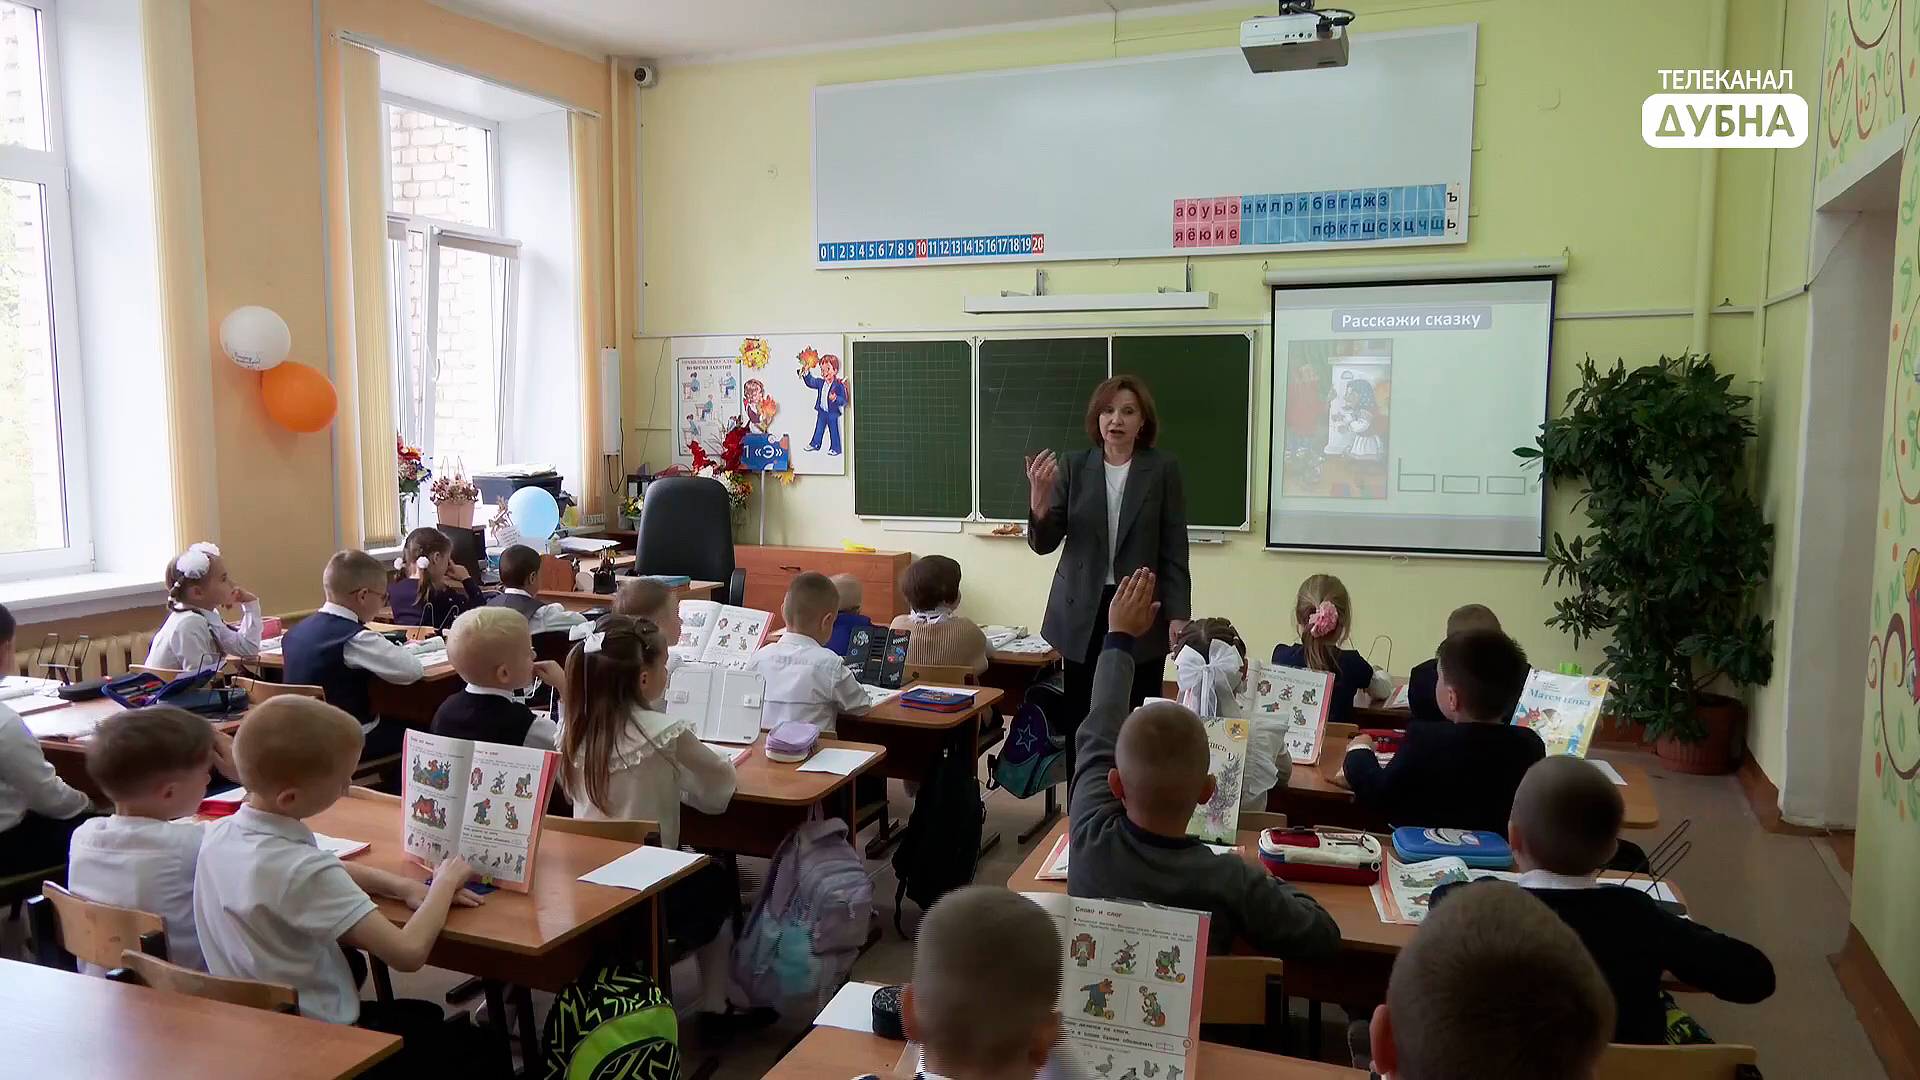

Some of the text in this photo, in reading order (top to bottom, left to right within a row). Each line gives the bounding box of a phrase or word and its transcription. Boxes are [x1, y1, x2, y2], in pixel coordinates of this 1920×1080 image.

[820, 237, 1043, 259] 0 1 2 3 4 5 6 7 8 9 10 11 12 13 14 15 16 17 18 19 20
[1342, 314, 1481, 328] Расскажи сказку
[744, 444, 783, 459] 1 «Э»
